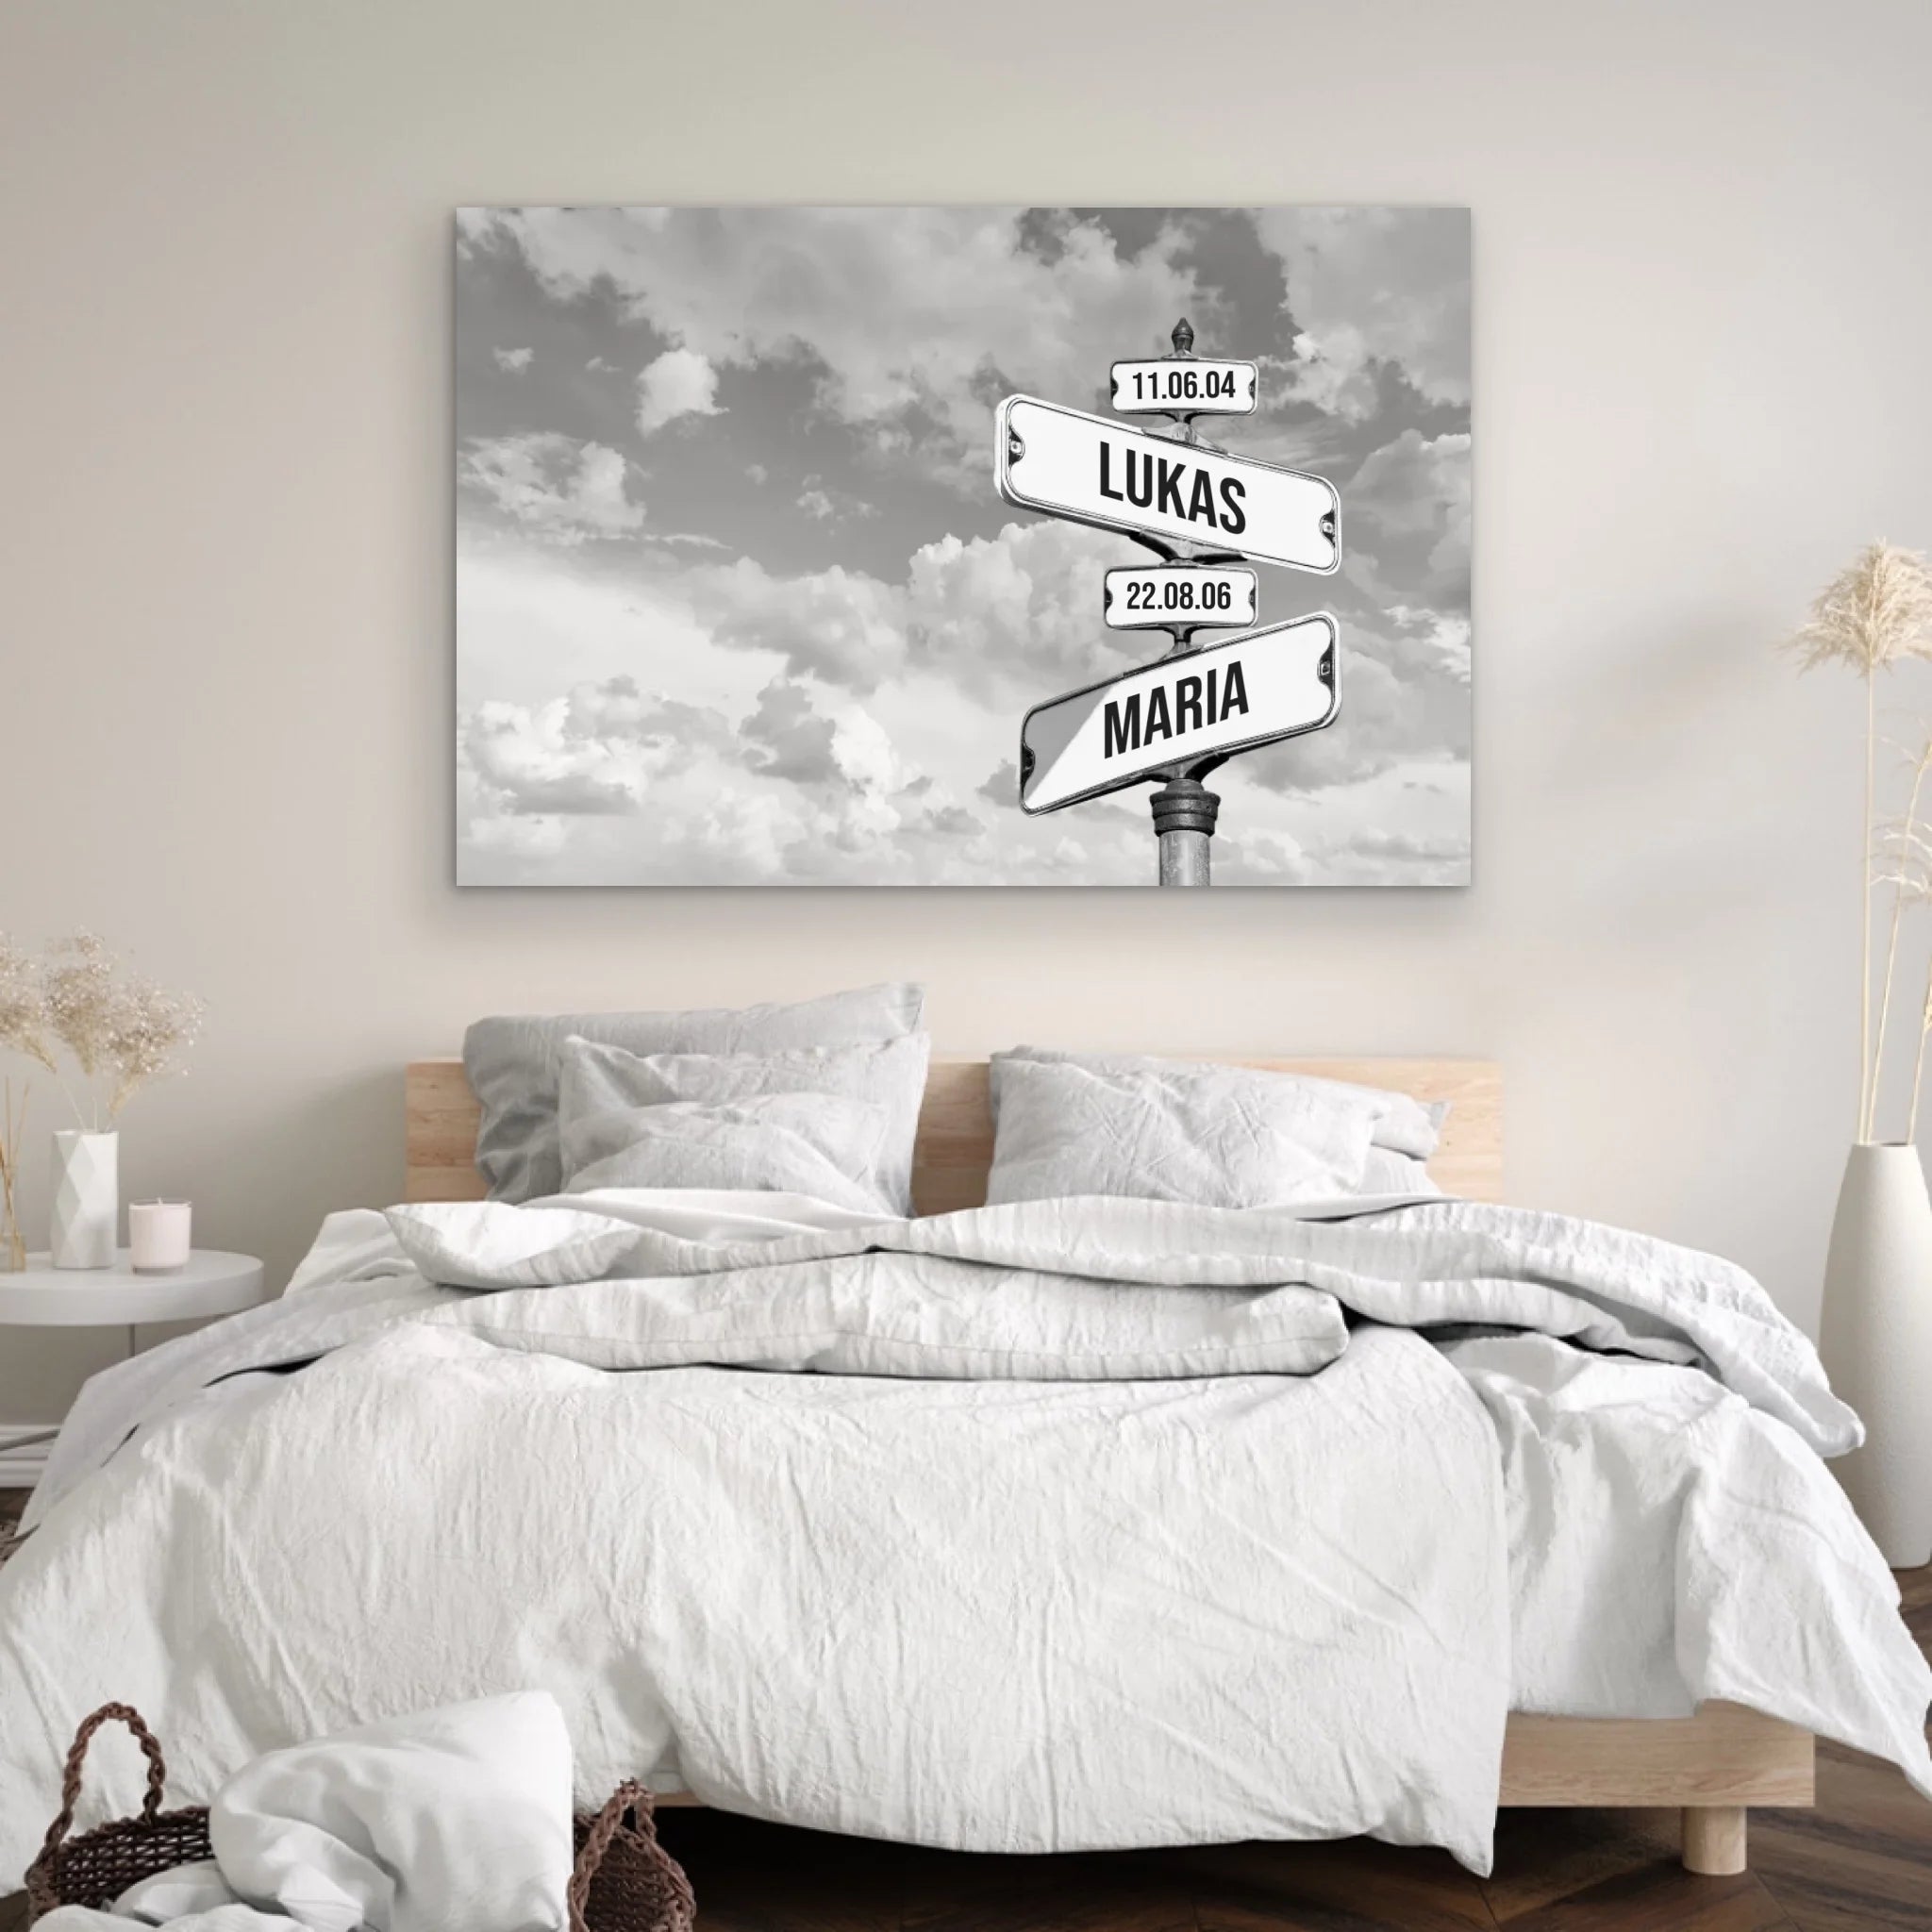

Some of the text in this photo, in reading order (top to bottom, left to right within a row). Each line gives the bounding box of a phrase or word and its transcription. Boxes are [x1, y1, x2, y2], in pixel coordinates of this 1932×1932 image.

[1132, 371, 1236, 400] 11.06.04
[1099, 441, 1247, 535] LUKAS
[1126, 581, 1231, 610] 22.08.06
[1103, 660, 1250, 759] MARIA
